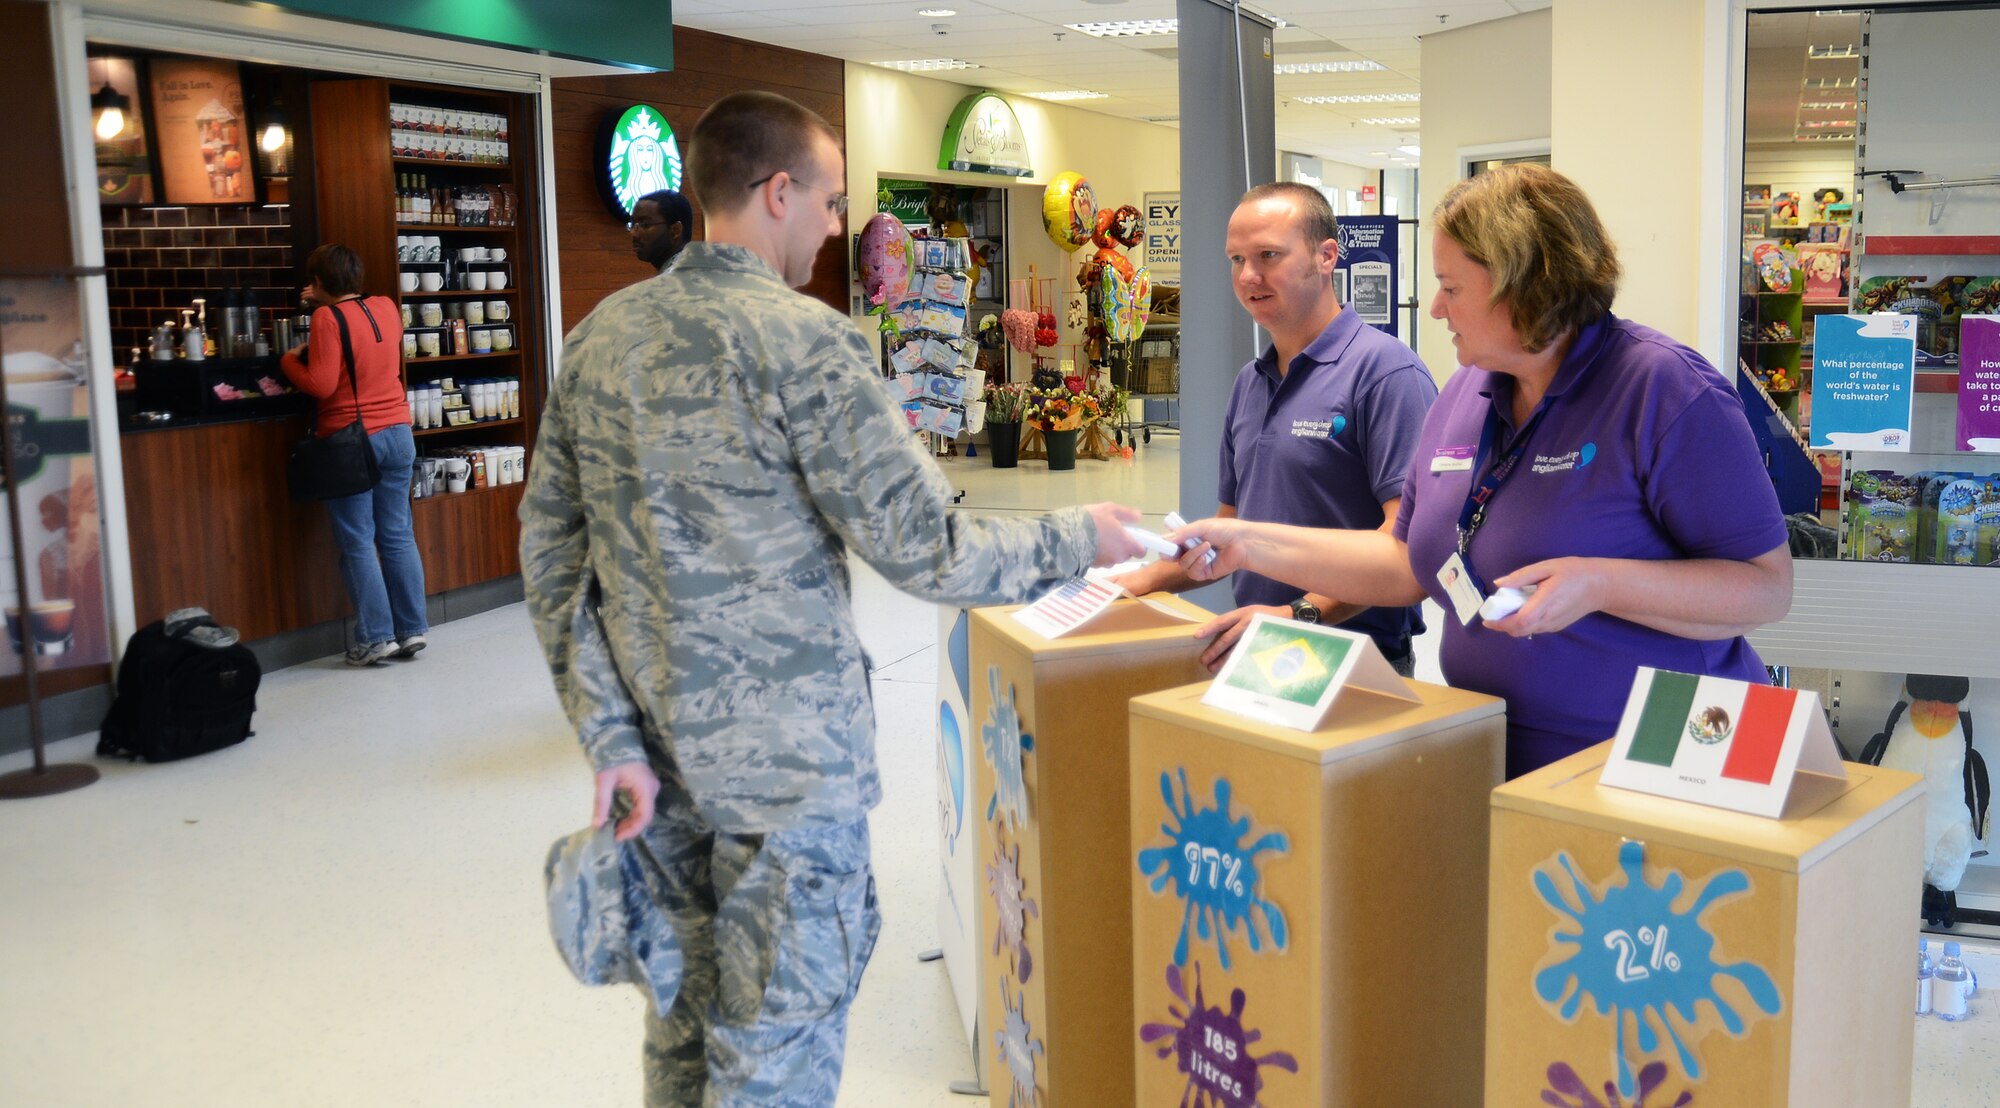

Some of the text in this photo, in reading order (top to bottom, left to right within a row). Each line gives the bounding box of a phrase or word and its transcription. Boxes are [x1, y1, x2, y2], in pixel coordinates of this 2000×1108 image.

[1822, 359, 1904, 371] What percentage
[1850, 370, 1878, 379] of the
[1826, 381, 1900, 391] world's water is
[1966, 381, 2000, 390] take to
[1833, 391, 1889, 401] freshwater?
[1979, 403, 1991, 412] of
[1679, 775, 1707, 785] MEXICO
[1184, 841, 1244, 897] 97%
[1603, 924, 1682, 983] 2%
[1203, 1025, 1238, 1061] 185
[1191, 1049, 1242, 1099] litres
